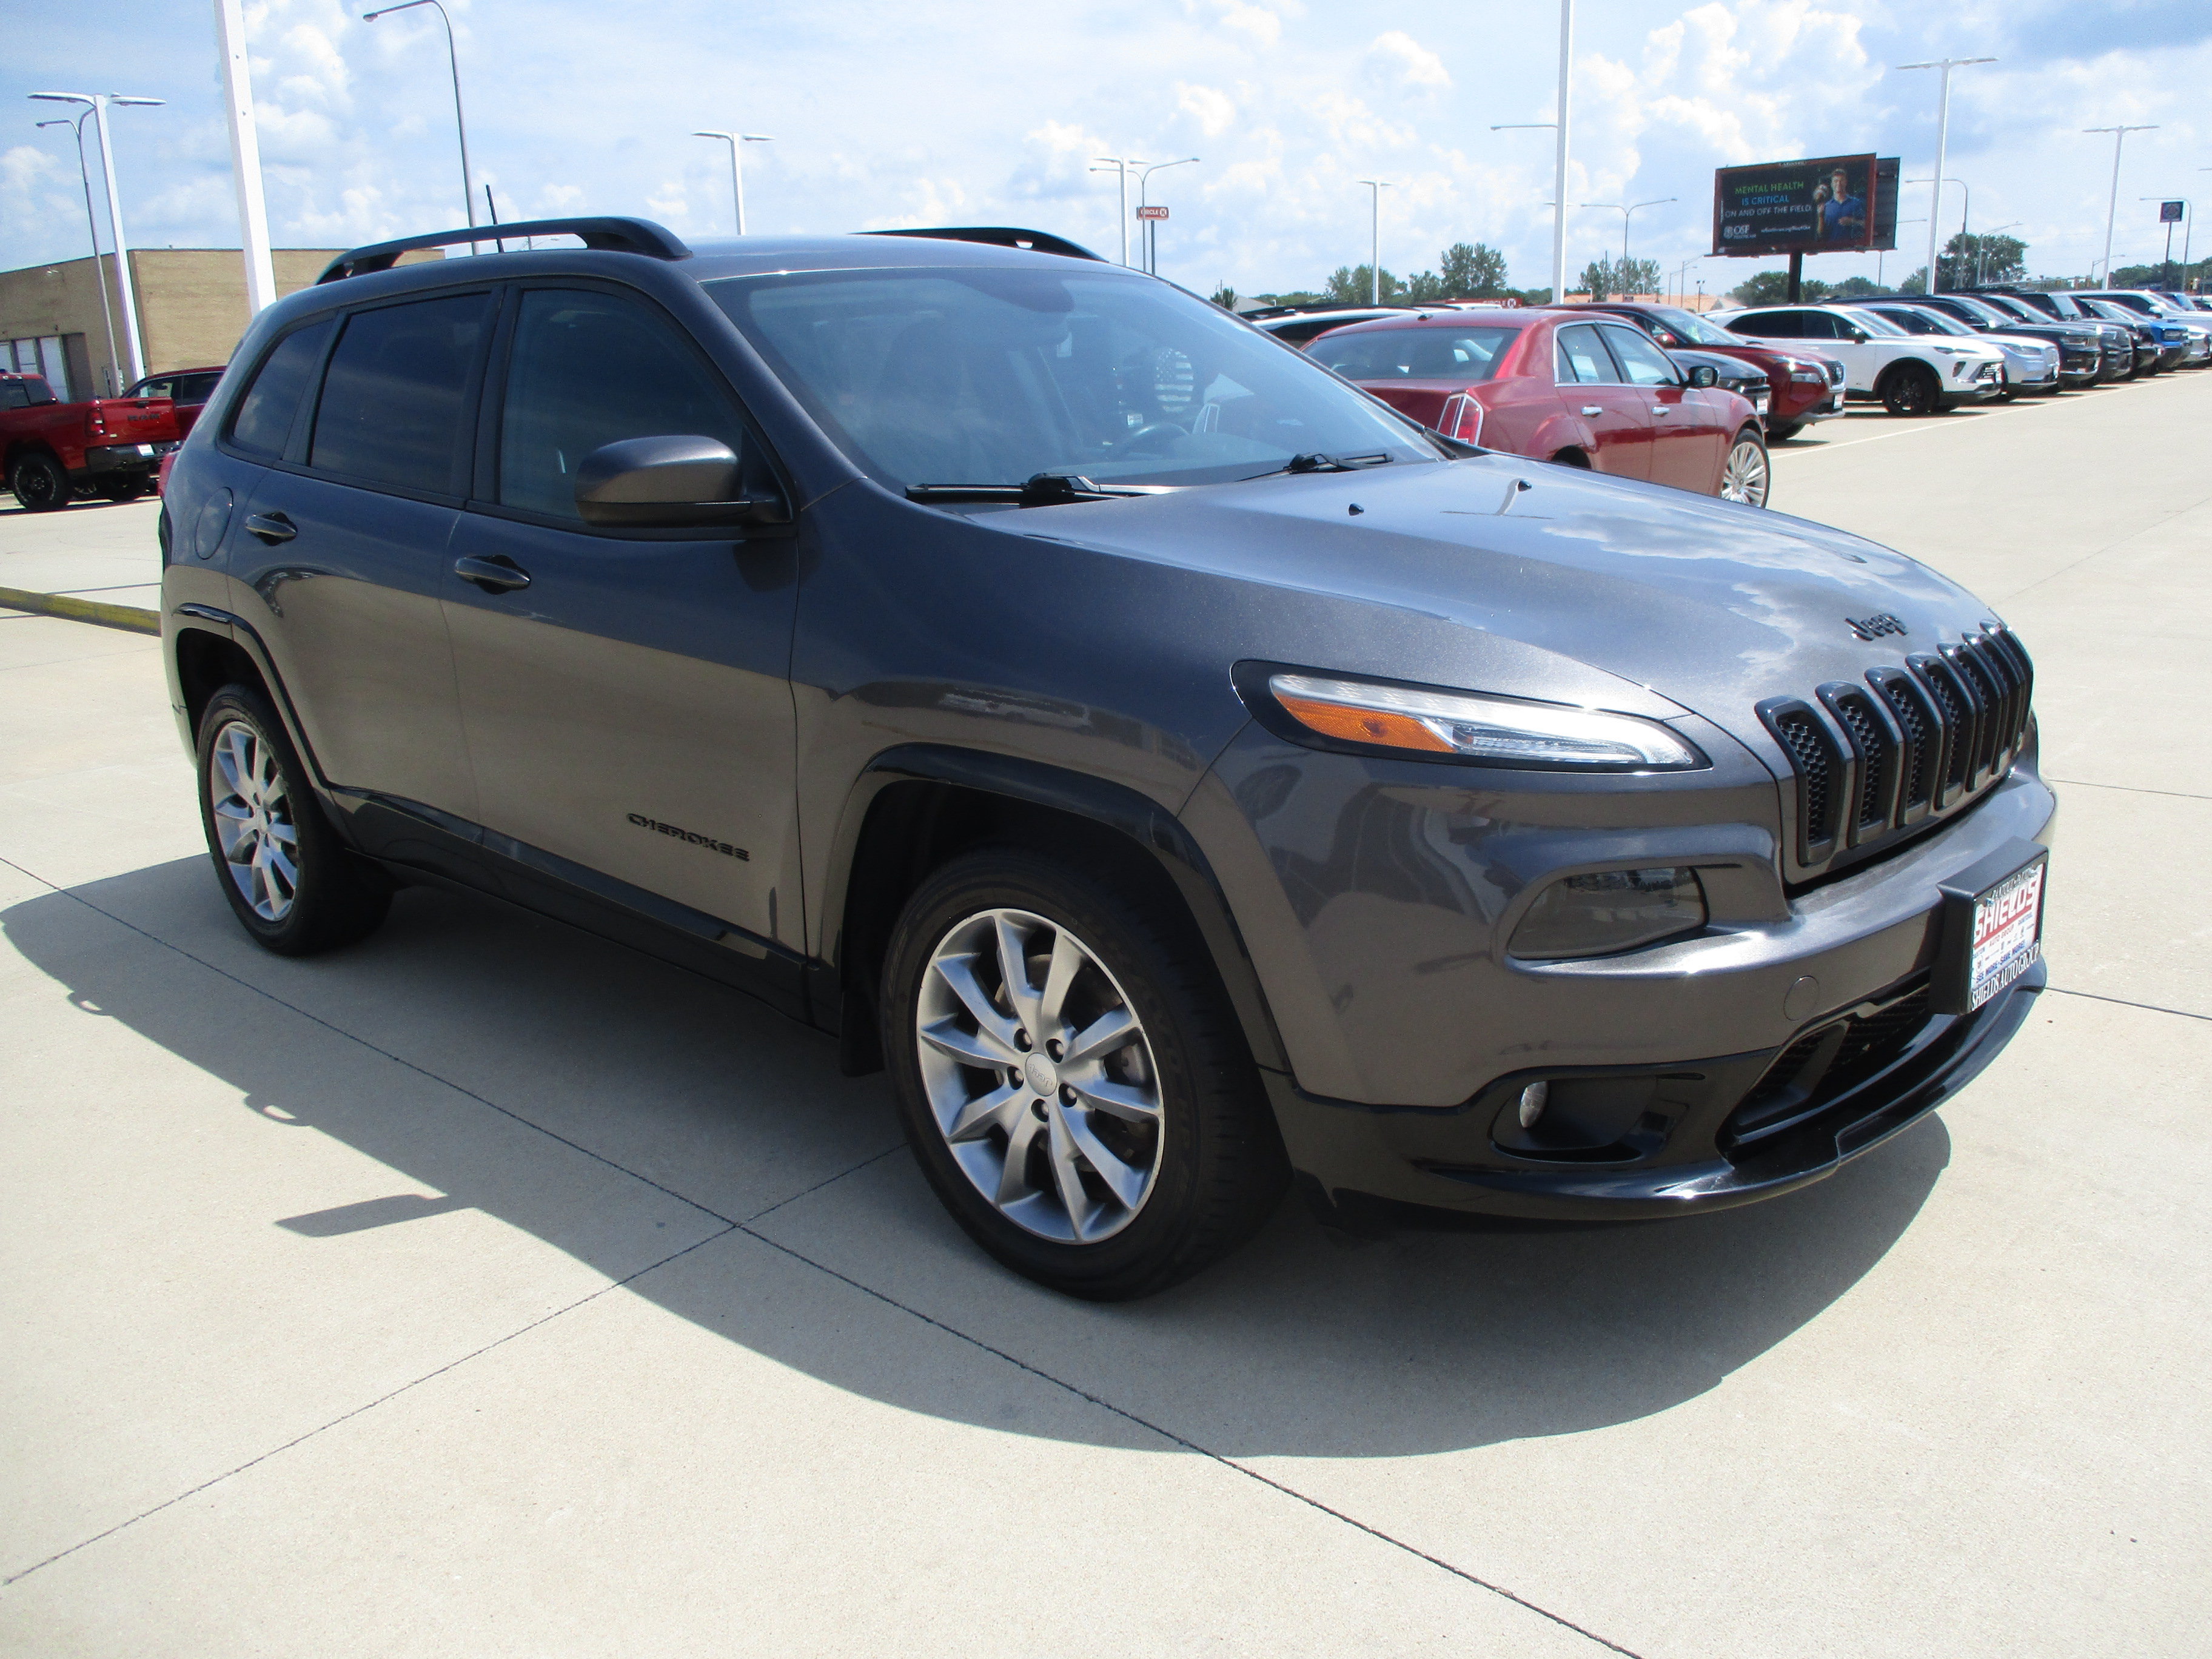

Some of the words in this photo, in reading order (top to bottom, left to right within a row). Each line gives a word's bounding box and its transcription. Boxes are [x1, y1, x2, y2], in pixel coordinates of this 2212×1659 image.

[1735, 184, 1768, 195] MENTAL
[1771, 181, 1804, 192] HEALTH
[1751, 195, 1789, 205] CRITICAL
[1738, 209, 1755, 217] AND
[1757, 207, 1772, 216] OFF
[1845, 613, 1909, 641] Jeep
[626, 813, 751, 862] CHEROKEE
[1973, 877, 2037, 942] SHIELDS
[1971, 973, 2000, 1011] SHIELDS
[1999, 960, 2018, 990] AUTO
[2018, 943, 2039, 974] GROUP
[1029, 1064, 1053, 1087] Jeep
